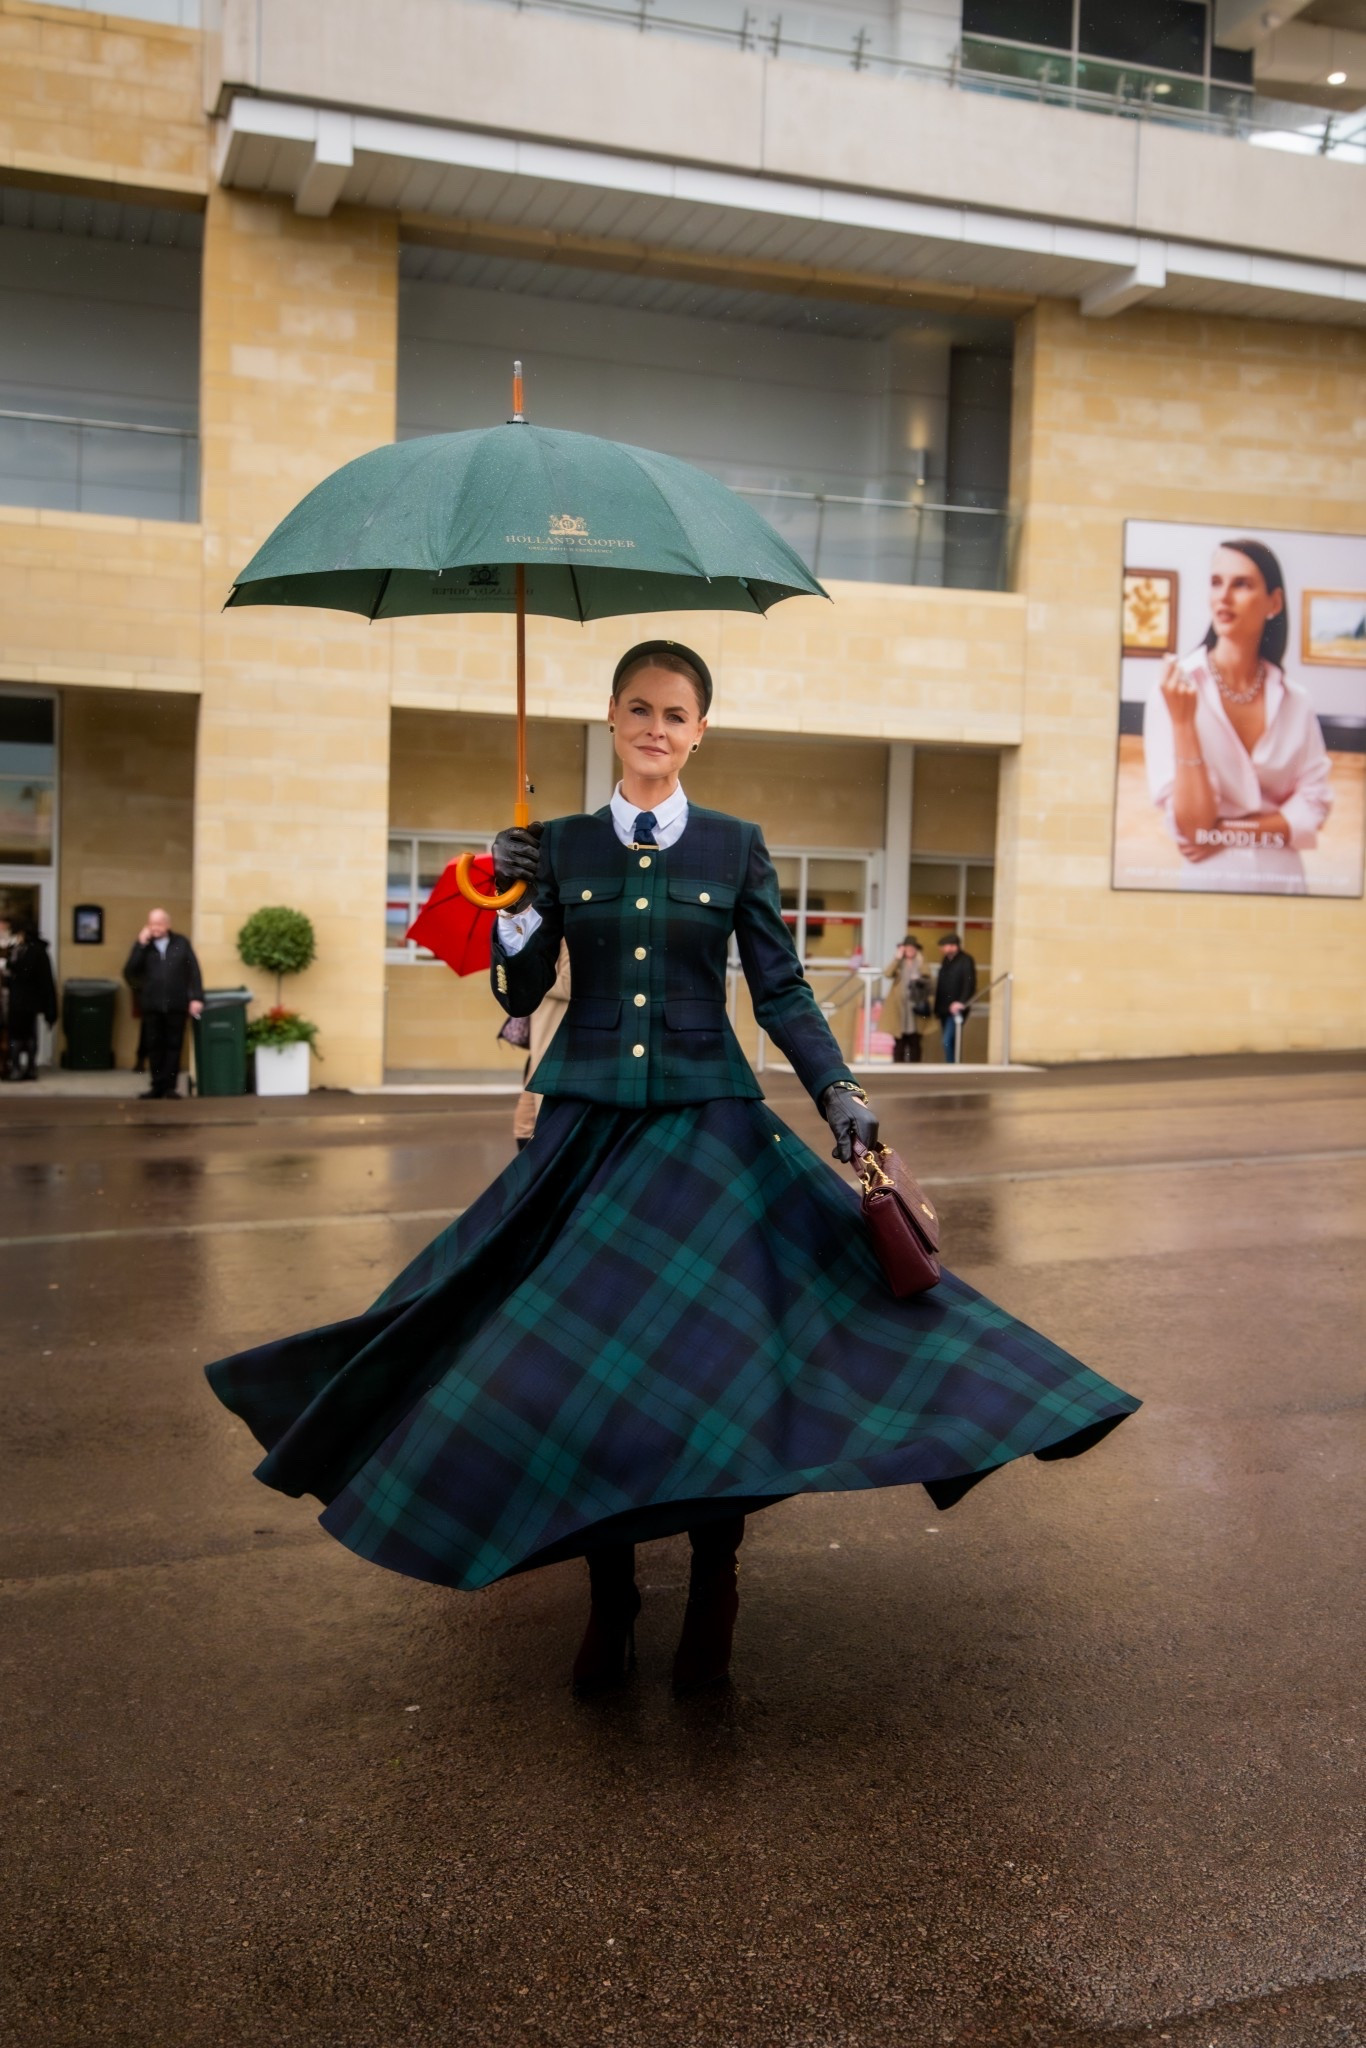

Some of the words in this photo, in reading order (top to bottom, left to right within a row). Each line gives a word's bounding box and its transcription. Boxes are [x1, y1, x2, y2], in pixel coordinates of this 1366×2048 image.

[505, 535, 575, 545] HOLLAND
[578, 538, 636, 548] COOPER
[1195, 828, 1285, 849] BOODLES
